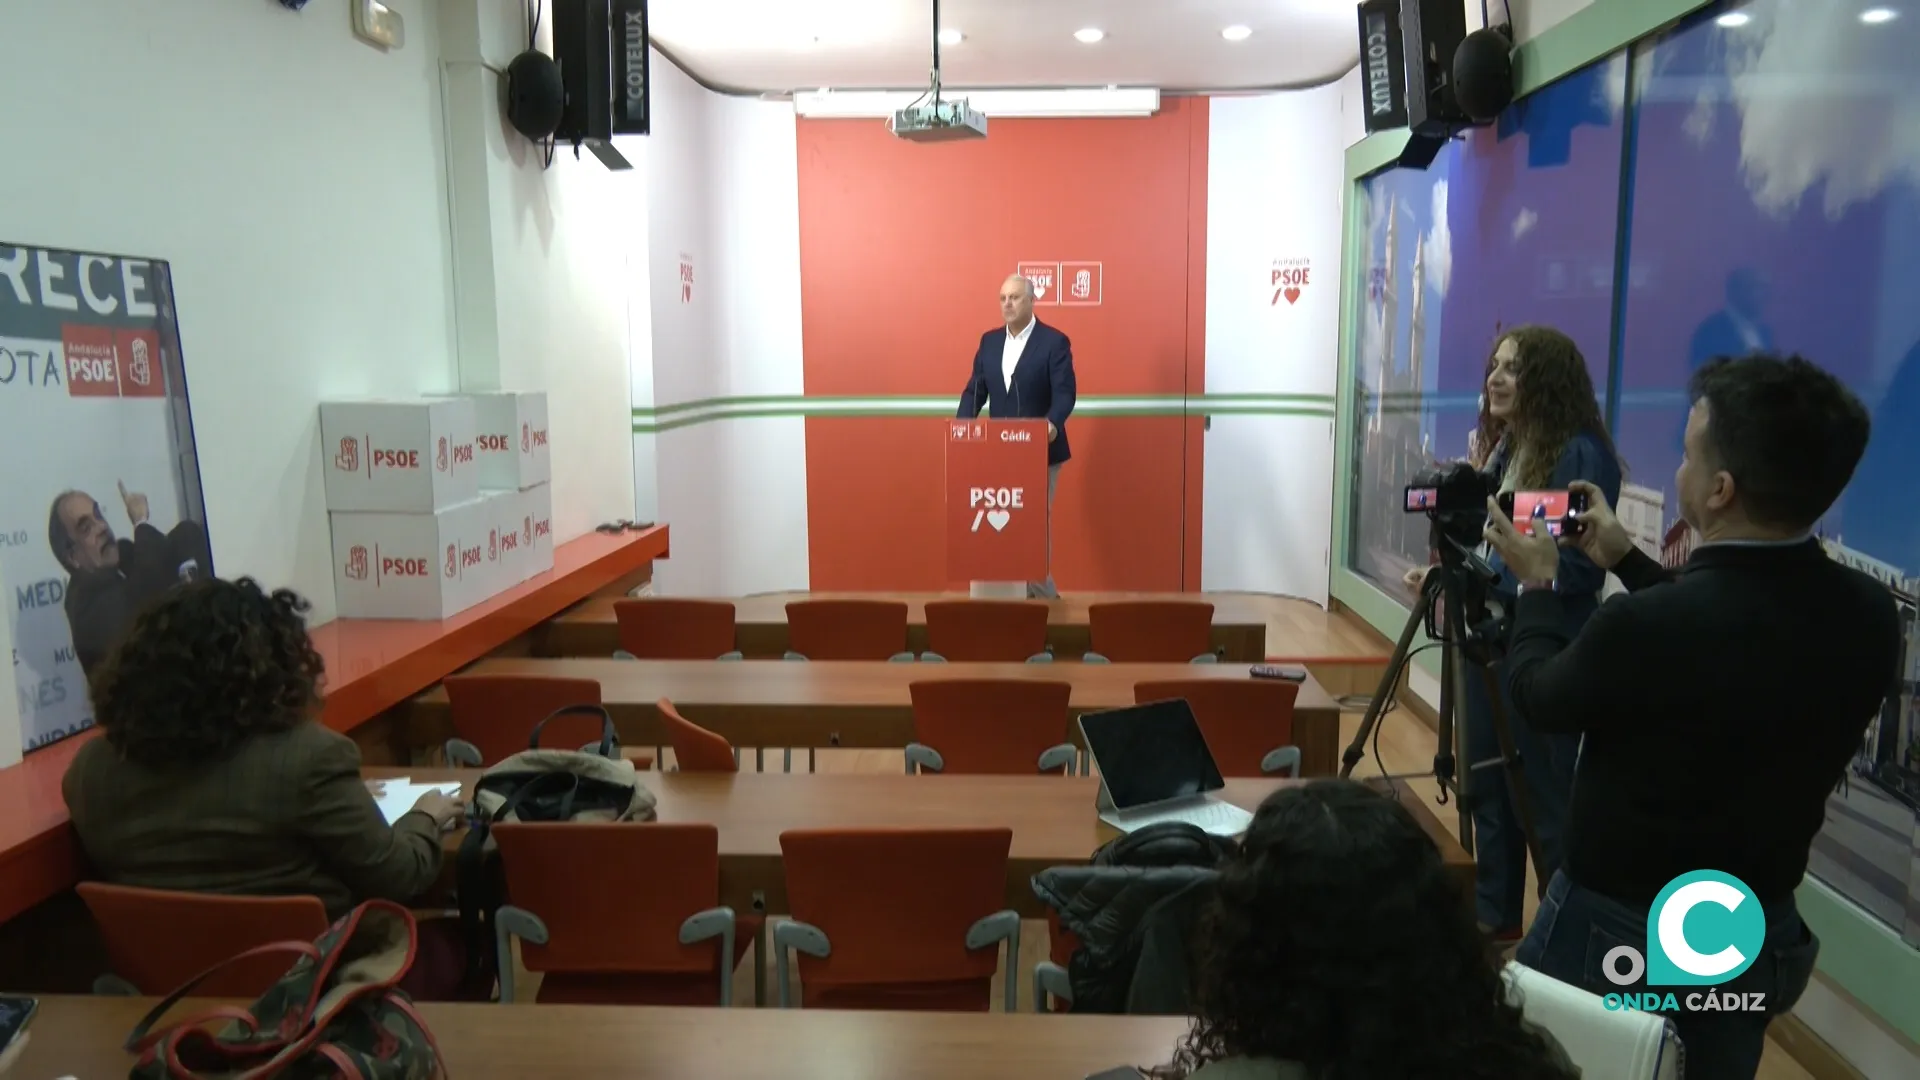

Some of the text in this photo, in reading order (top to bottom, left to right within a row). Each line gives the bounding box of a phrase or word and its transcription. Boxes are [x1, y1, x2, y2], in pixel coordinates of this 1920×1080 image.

[626, 10, 644, 100] COTELUX
[1367, 33, 1392, 116] COTELUX
[1271, 267, 1310, 286] PSOE
[69, 356, 115, 383] PSOE
[475, 434, 509, 451] SOE
[533, 429, 547, 446] PSOE
[1000, 429, 1032, 442] Cádiz
[373, 449, 419, 468] PSOE
[453, 443, 473, 464] PSOE
[970, 486, 1024, 509] PSOE
[535, 518, 550, 538] PSOE
[501, 531, 517, 551] PSOE
[382, 557, 429, 576] PSOE
[462, 545, 481, 568] PSOE
